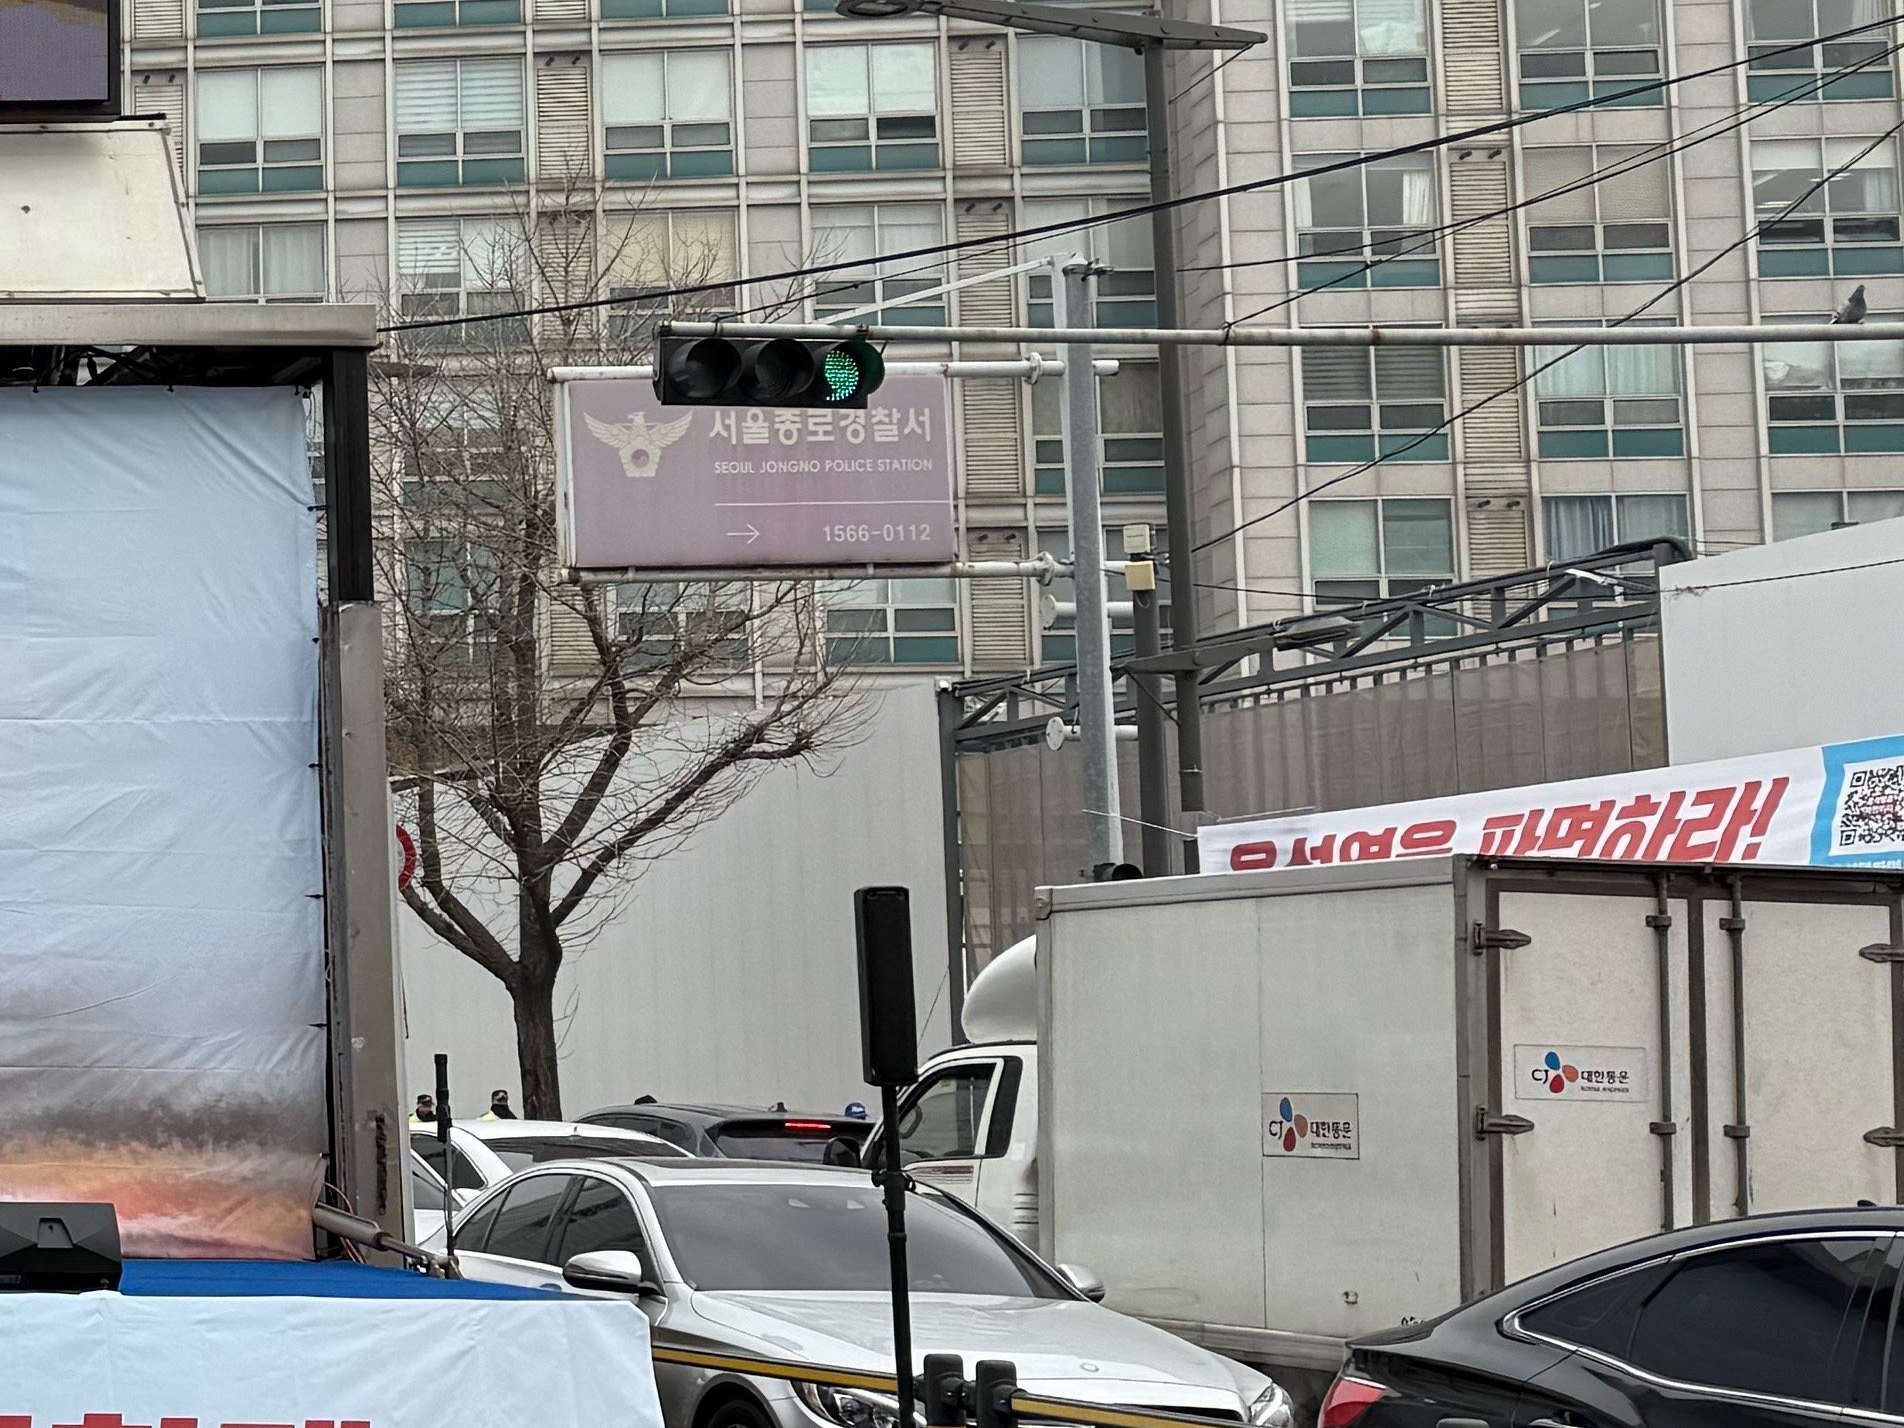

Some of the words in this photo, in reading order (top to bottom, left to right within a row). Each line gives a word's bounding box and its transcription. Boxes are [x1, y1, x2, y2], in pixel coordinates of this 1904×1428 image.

[708, 406, 933, 446] 서울종로경찰서
[713, 459, 757, 474] SEOUL
[760, 458, 821, 474] JONGNO
[824, 458, 875, 473] POLICE
[877, 457, 934, 472] STATION
[822, 523, 932, 543] 1566-0112
[1530, 1068, 1550, 1084] CJ
[1268, 1120, 1284, 1140] CJ
